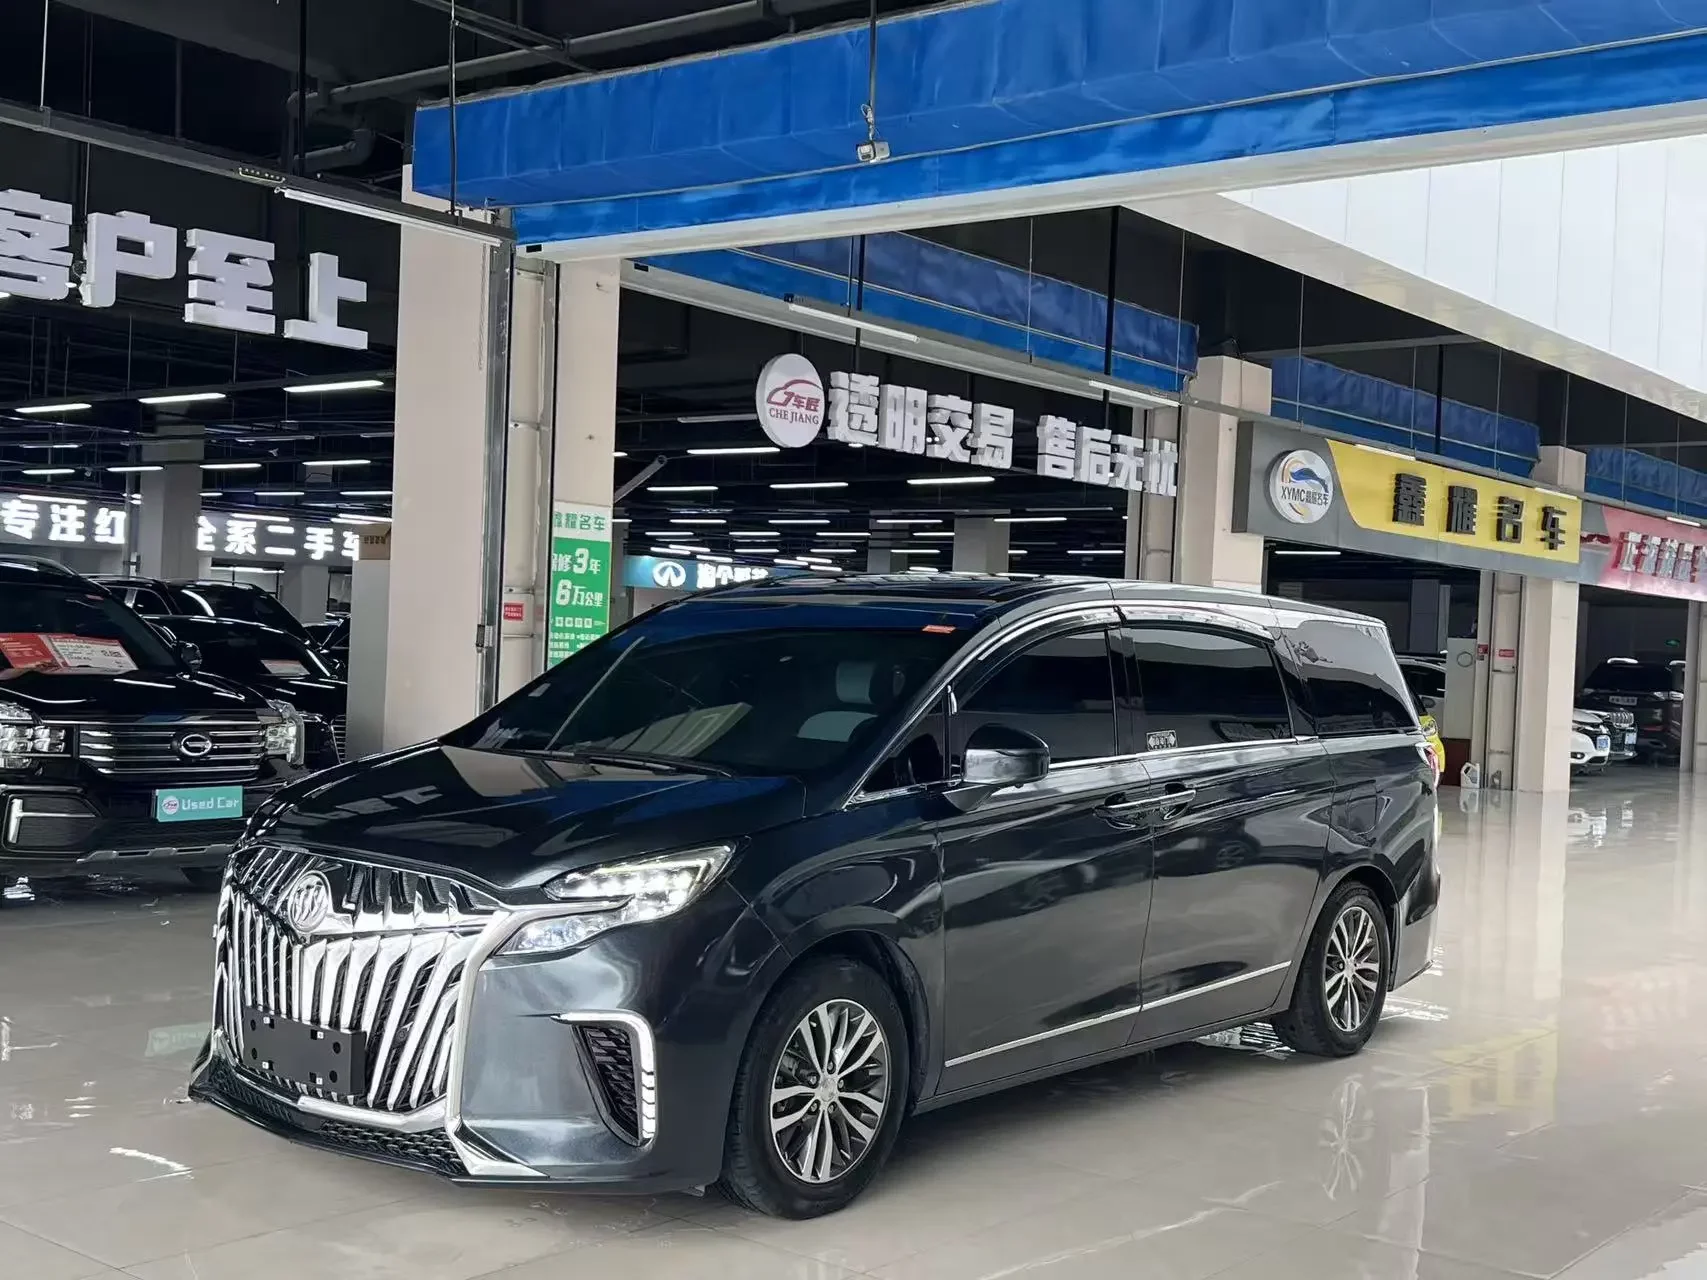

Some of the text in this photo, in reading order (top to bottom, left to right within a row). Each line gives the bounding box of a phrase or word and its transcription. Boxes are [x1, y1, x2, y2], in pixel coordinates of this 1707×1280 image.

[0, 189, 368, 350] 客户至上
[769, 407, 819, 425] CHE JIANG
[827, 371, 1014, 470] 透明交易
[181, 797, 214, 811] Used
[217, 796, 240, 809] Car
